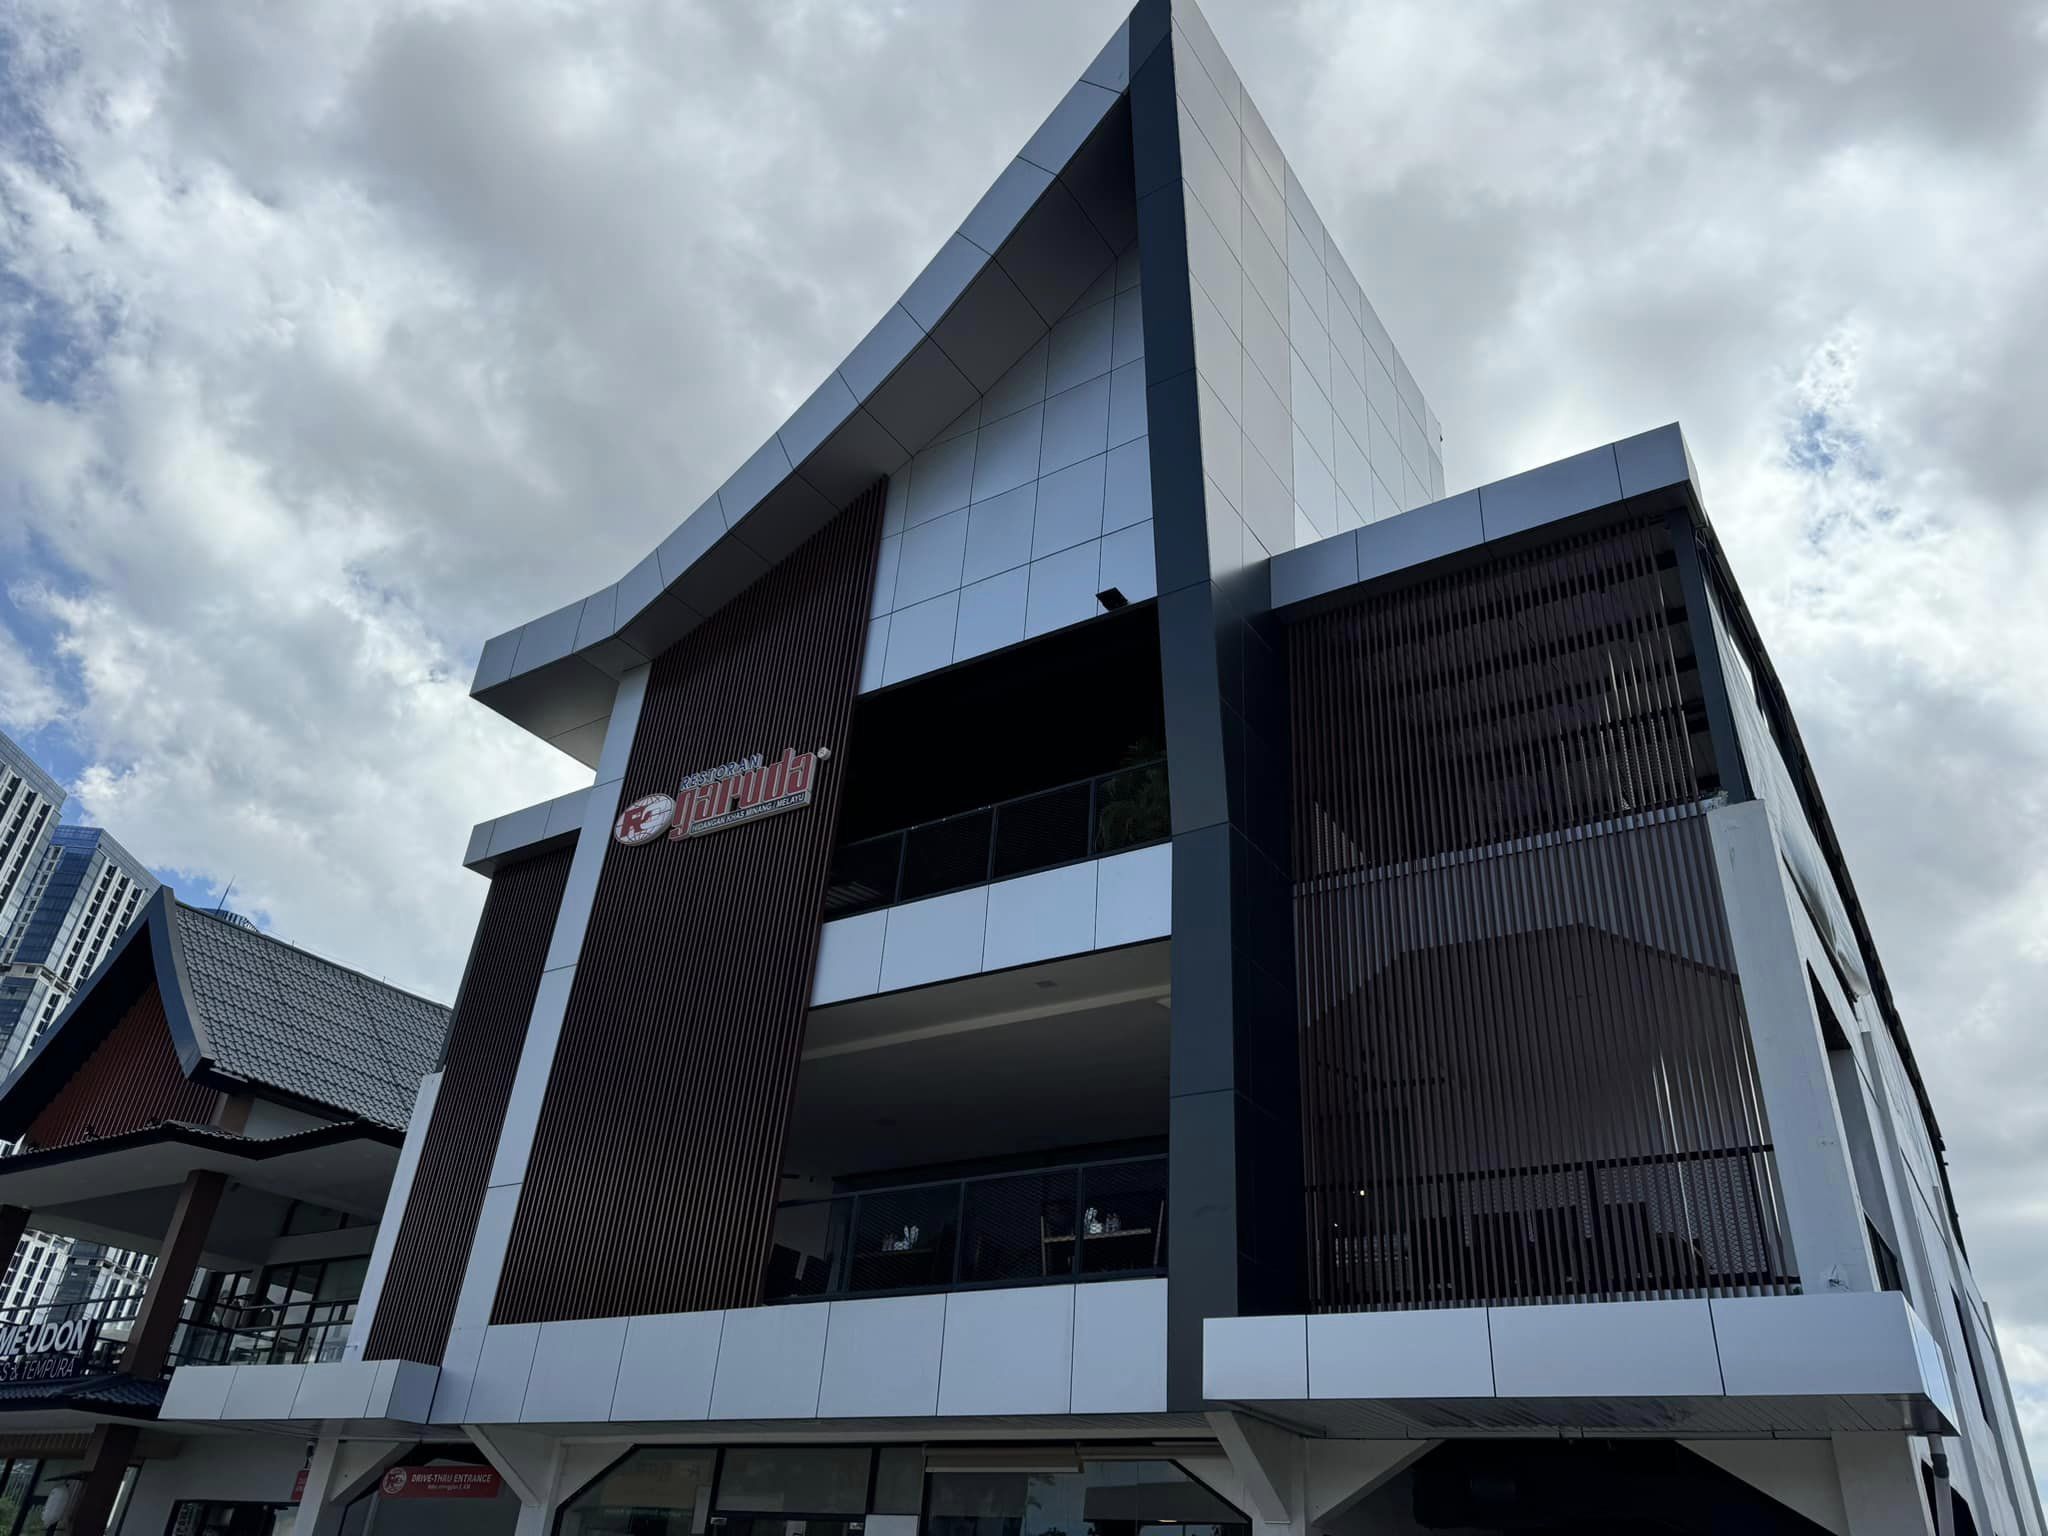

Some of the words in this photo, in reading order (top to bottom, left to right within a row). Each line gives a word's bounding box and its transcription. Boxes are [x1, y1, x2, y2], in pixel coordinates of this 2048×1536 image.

[681, 753, 763, 790] RESTORAN
[668, 747, 817, 841] garuda
[691, 816, 725, 832] HIDANGAN
[726, 811, 745, 823] KHAS
[745, 803, 773, 817] MINANG
[776, 794, 805, 808] MELAYU
[25, 1319, 91, 1353] UDON
[22, 1358, 75, 1380] TEMPURA
[411, 1474, 453, 1483] DRIVE-THRU
[454, 1473, 492, 1483] ENTRANCE
